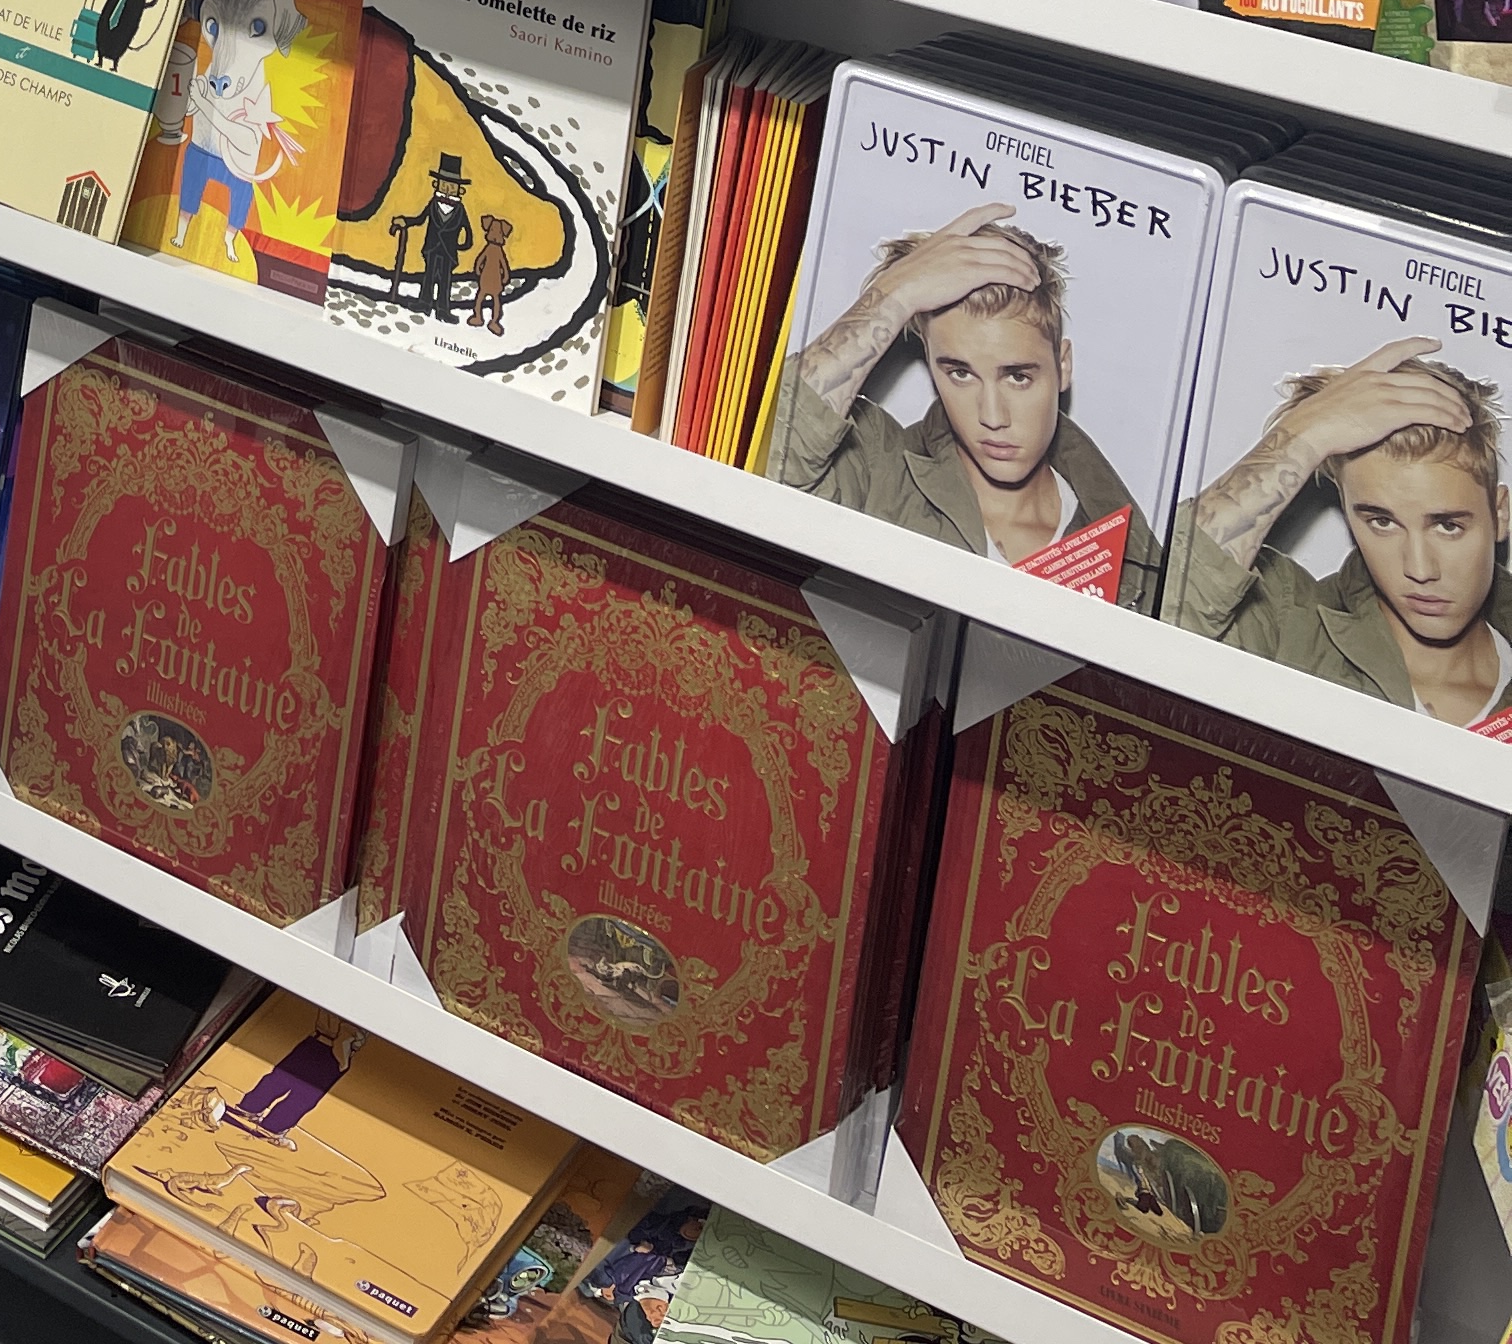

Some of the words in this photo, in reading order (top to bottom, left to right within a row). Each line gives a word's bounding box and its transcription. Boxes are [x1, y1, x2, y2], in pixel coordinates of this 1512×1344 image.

[13, 11, 29, 29] DE
[31, 17, 64, 43] VILLE
[509, 23, 548, 49] Saori
[554, 32, 614, 68] Kamino
[562, 12, 588, 34] de
[590, 21, 617, 44] riz
[19, 74, 73, 108] CHAMPS
[985, 129, 1056, 171] OFFICIEL
[860, 119, 993, 191] JUSTIN
[1019, 169, 1174, 241] BIEBER
[1259, 245, 1413, 324] JUSTIN
[1404, 256, 1488, 303] OFFICIEL
[433, 335, 479, 360] Lirabelle
[126, 517, 257, 627] Fables
[571, 695, 733, 825] Fables
[1108, 889, 1295, 1026] Fables
